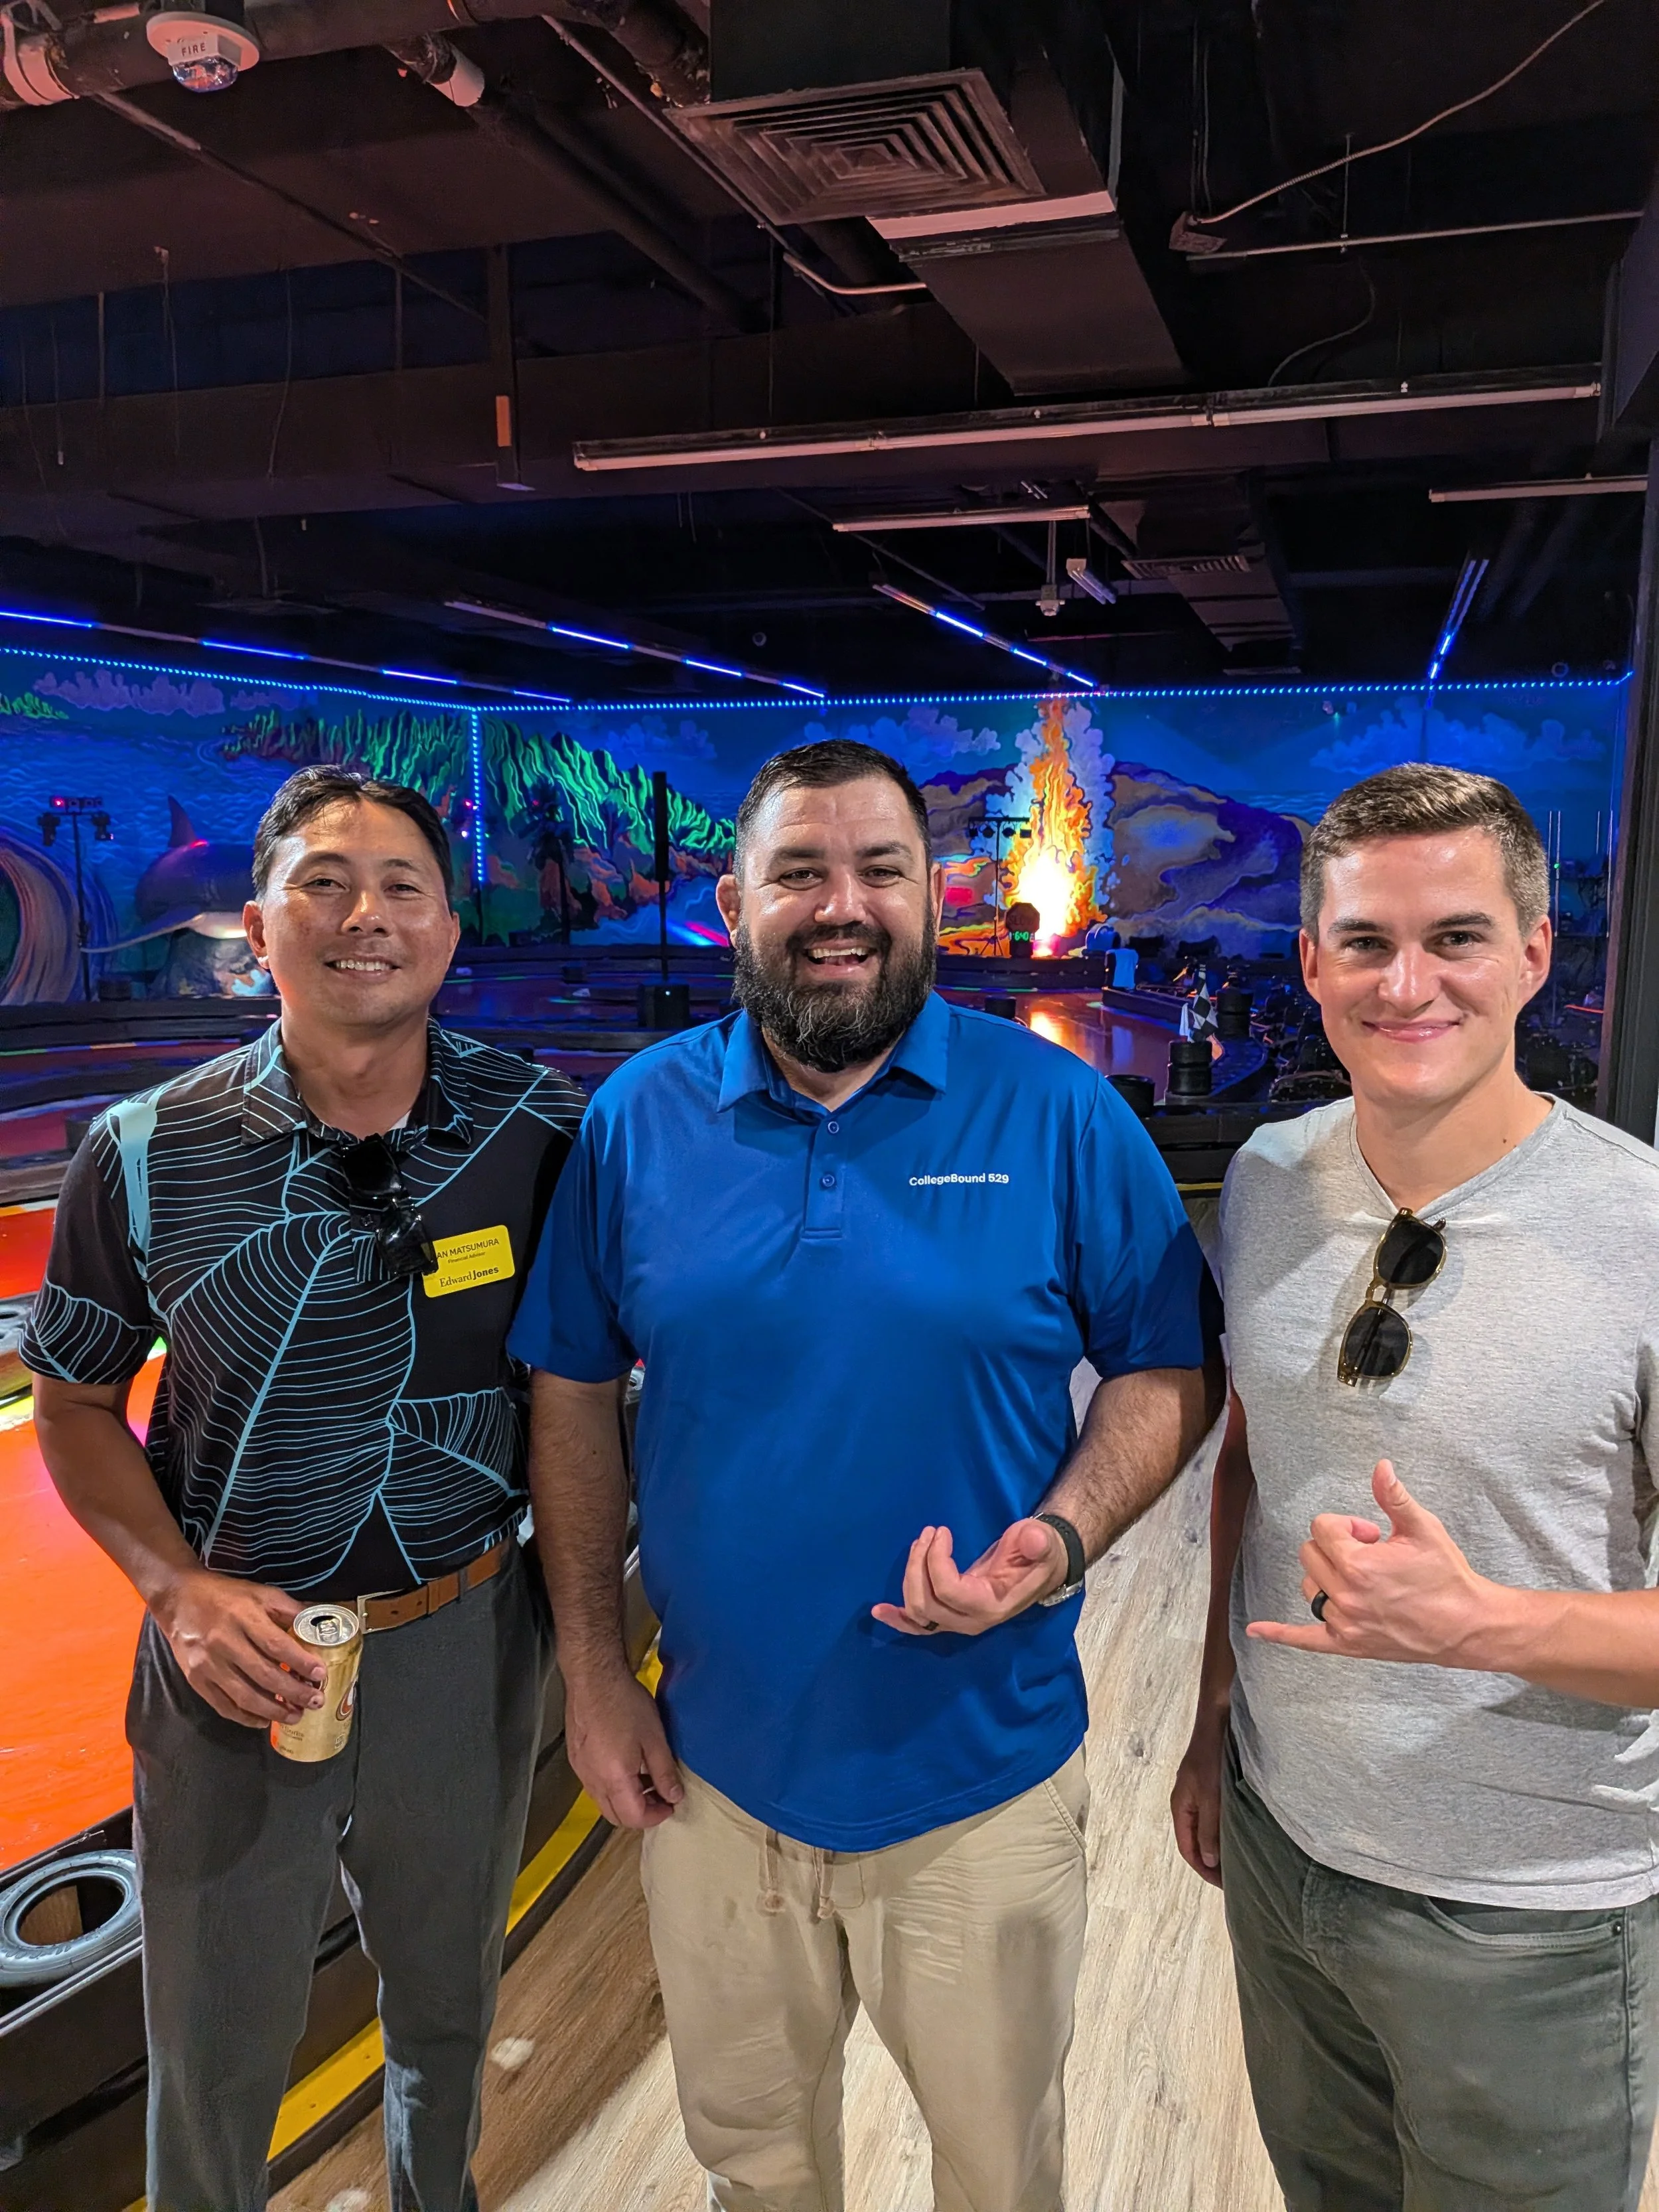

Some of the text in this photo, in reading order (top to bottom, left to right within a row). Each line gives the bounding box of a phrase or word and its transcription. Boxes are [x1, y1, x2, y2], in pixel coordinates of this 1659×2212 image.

[182, 43, 206, 56] FIRE
[909, 1173, 1009, 1186] CollegeBound 529
[449, 1238, 500, 1256] MATSUMURA
[448, 1255, 469, 1264] Financial
